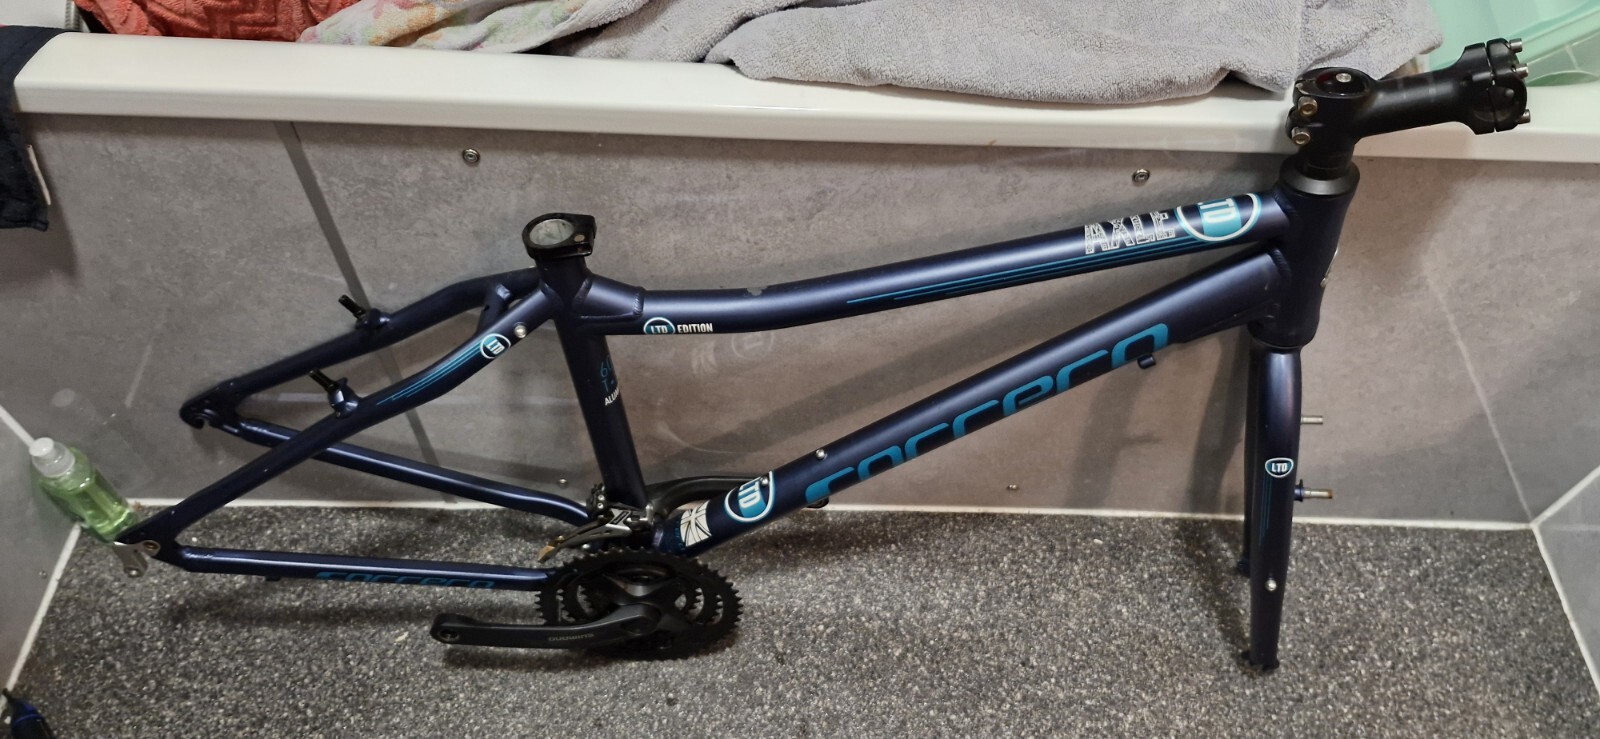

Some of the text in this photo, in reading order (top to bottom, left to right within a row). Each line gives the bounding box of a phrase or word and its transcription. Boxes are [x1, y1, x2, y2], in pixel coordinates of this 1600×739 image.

[1197, 198, 1237, 224] TD
[1085, 211, 1175, 254] AXLE
[677, 323, 713, 333] EDITION
[1271, 462, 1288, 473] LTD
